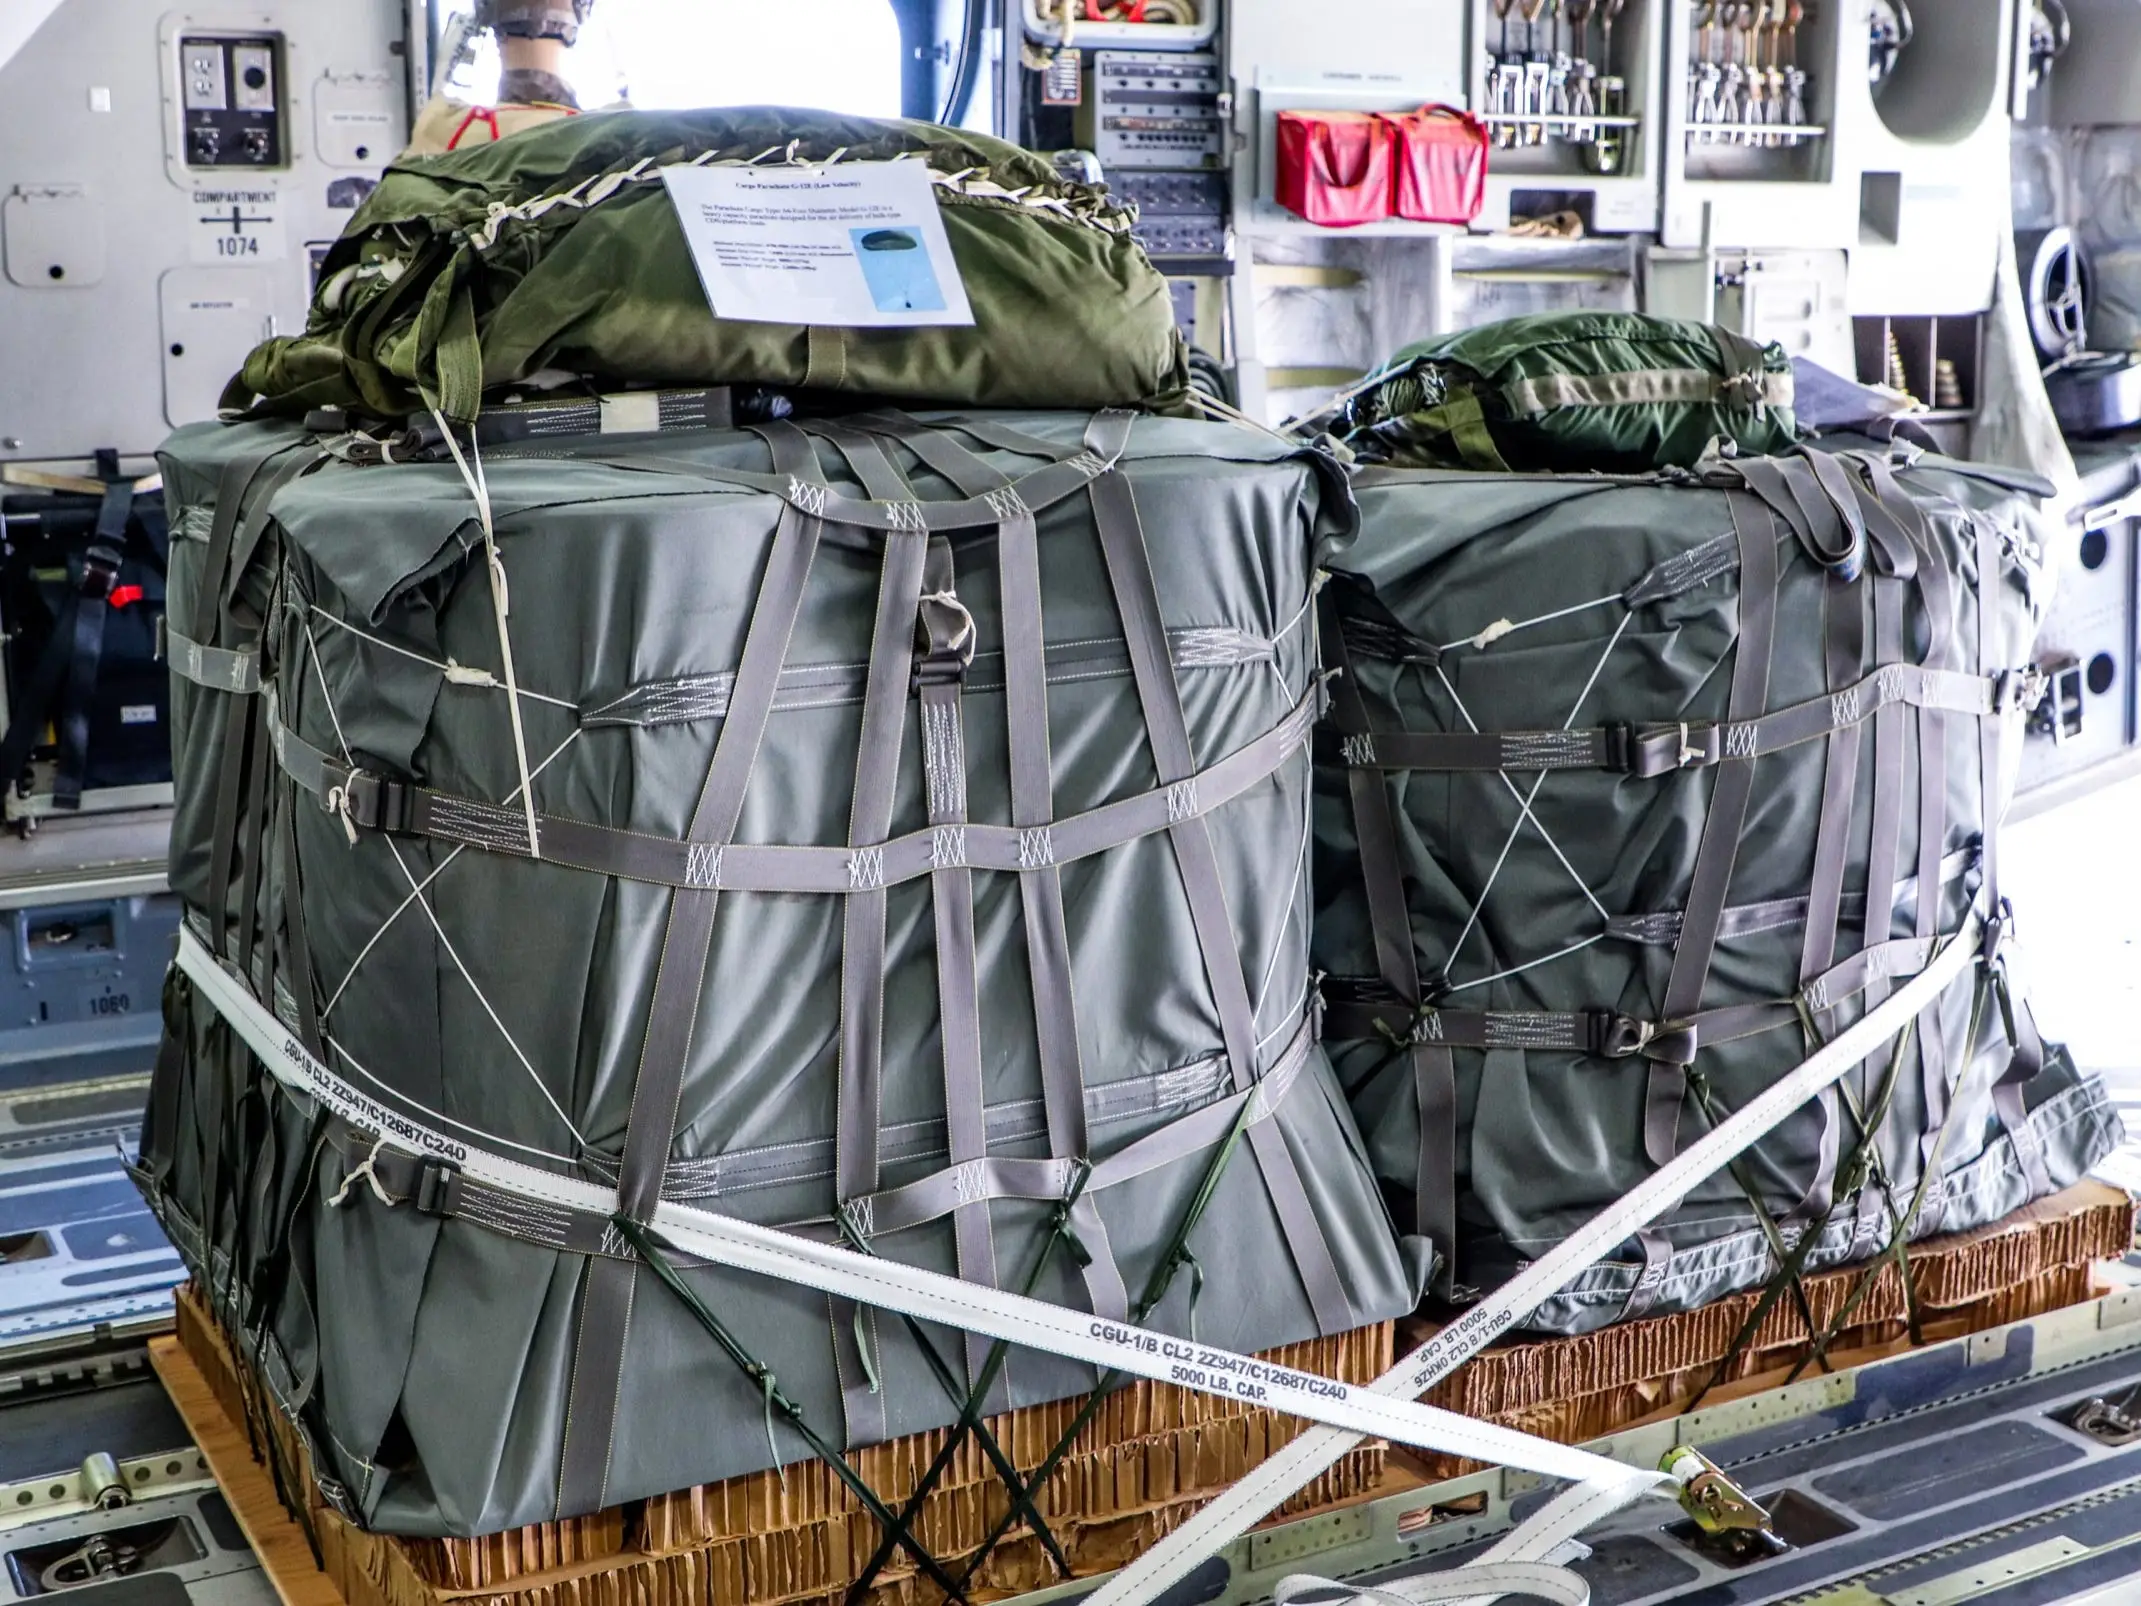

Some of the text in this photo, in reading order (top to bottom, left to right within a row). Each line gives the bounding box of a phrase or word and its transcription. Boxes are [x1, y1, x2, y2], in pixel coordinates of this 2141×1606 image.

[193, 191, 276, 203] COMPARTMENT
[217, 237, 258, 256] 1074
[313, 1066, 331, 1090] CL2
[1090, 1323, 1158, 1353] CGU-1/B
[1162, 1341, 1194, 1362] CL2
[1416, 1308, 1488, 1363] 5000 LB. CAP.
[1469, 1309, 1512, 1346] CGU-1/B
[1448, 1342, 1469, 1361] CL2
[1171, 1365, 1268, 1401] 5000 LB. CAP.
